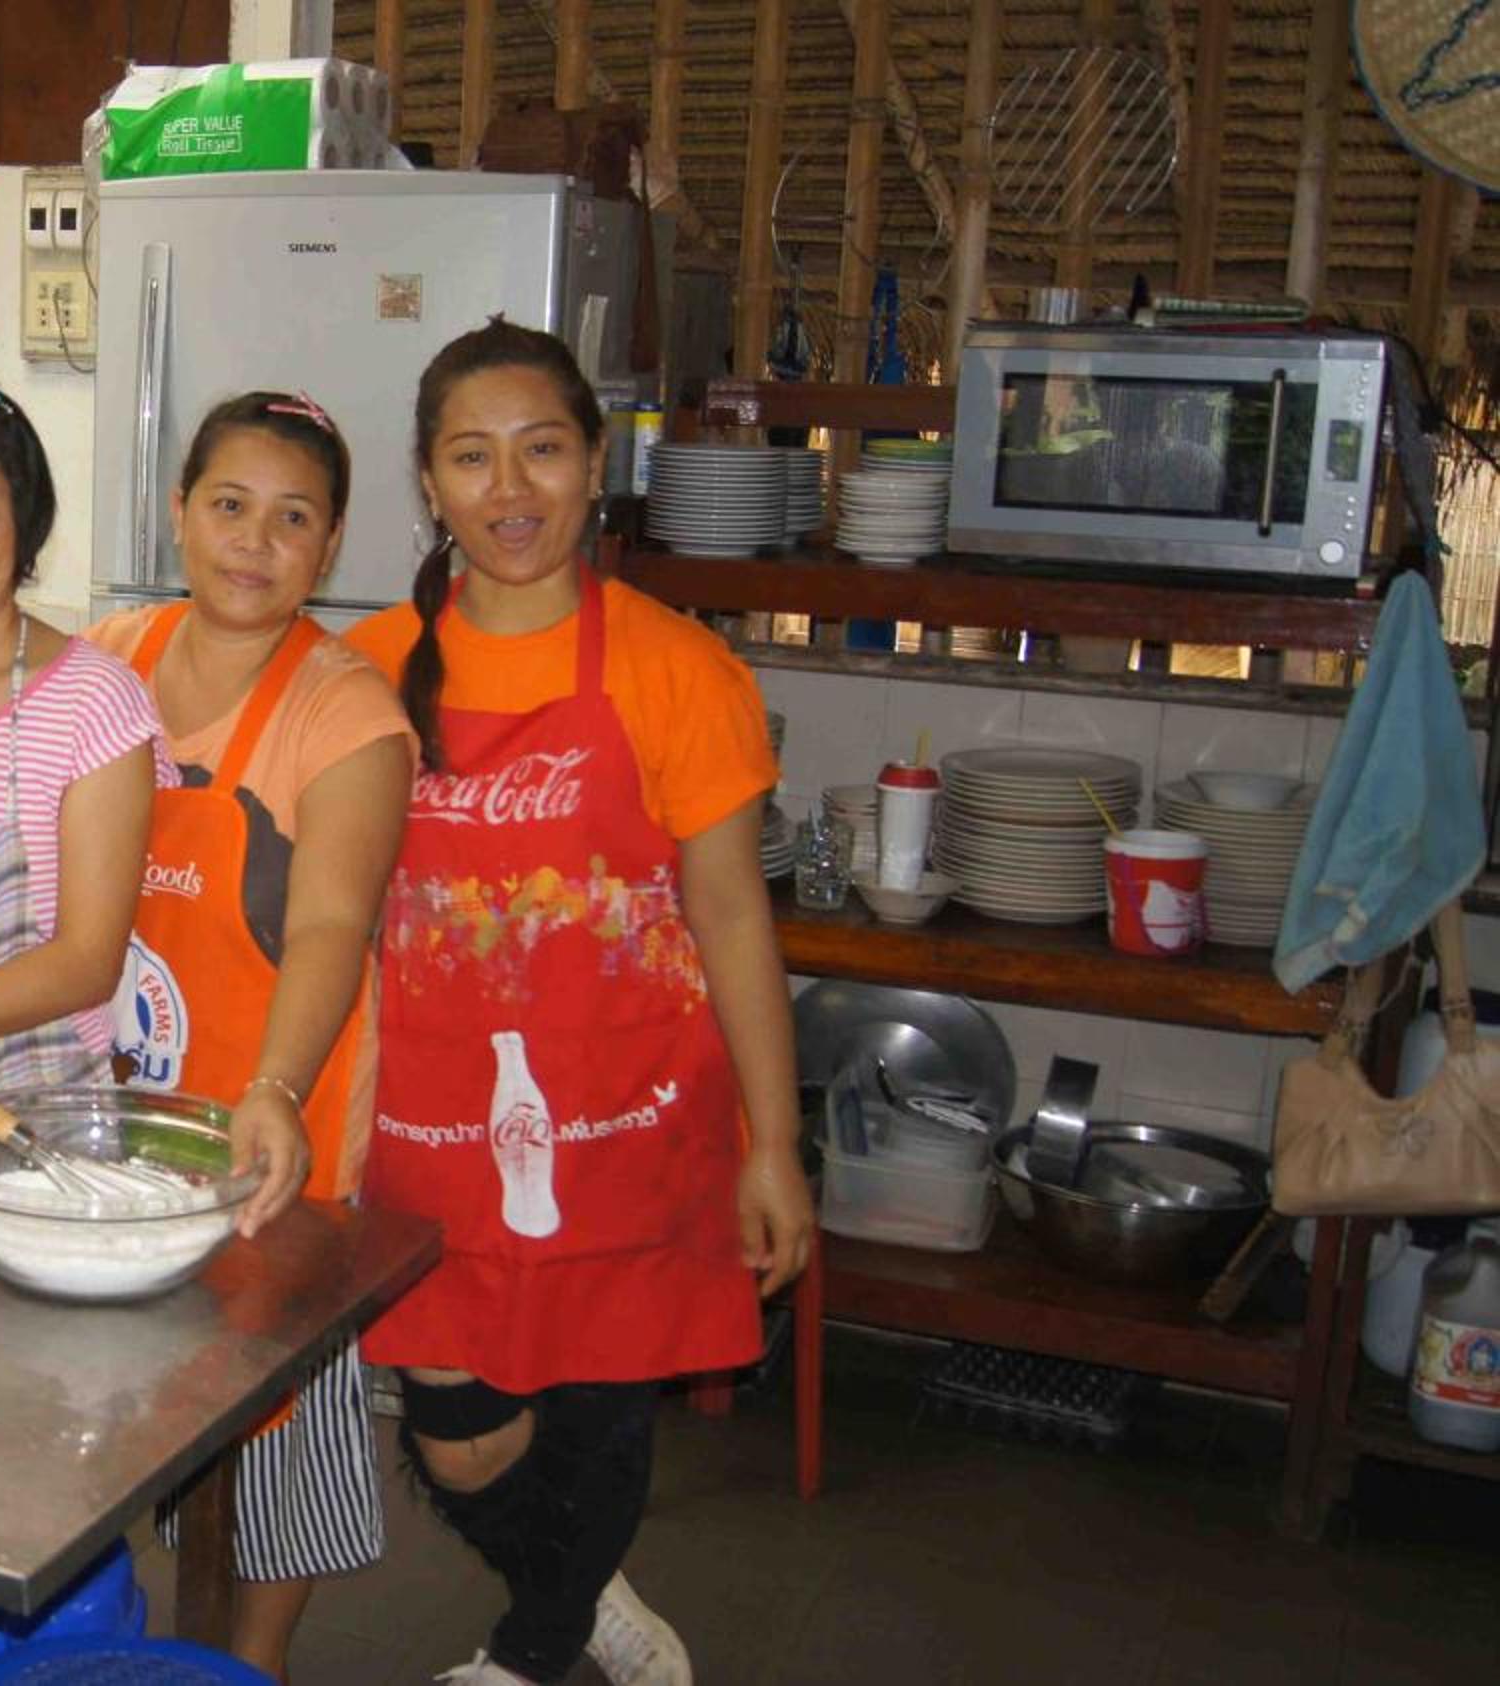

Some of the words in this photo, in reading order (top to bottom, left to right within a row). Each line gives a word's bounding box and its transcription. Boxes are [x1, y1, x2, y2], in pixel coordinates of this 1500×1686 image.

[204, 114, 244, 131] VALUE
[162, 138, 189, 153] Roll
[287, 242, 338, 254] SIEMENS
[406, 748, 596, 826] oca-Cola
[139, 973, 172, 1043] FARMS
